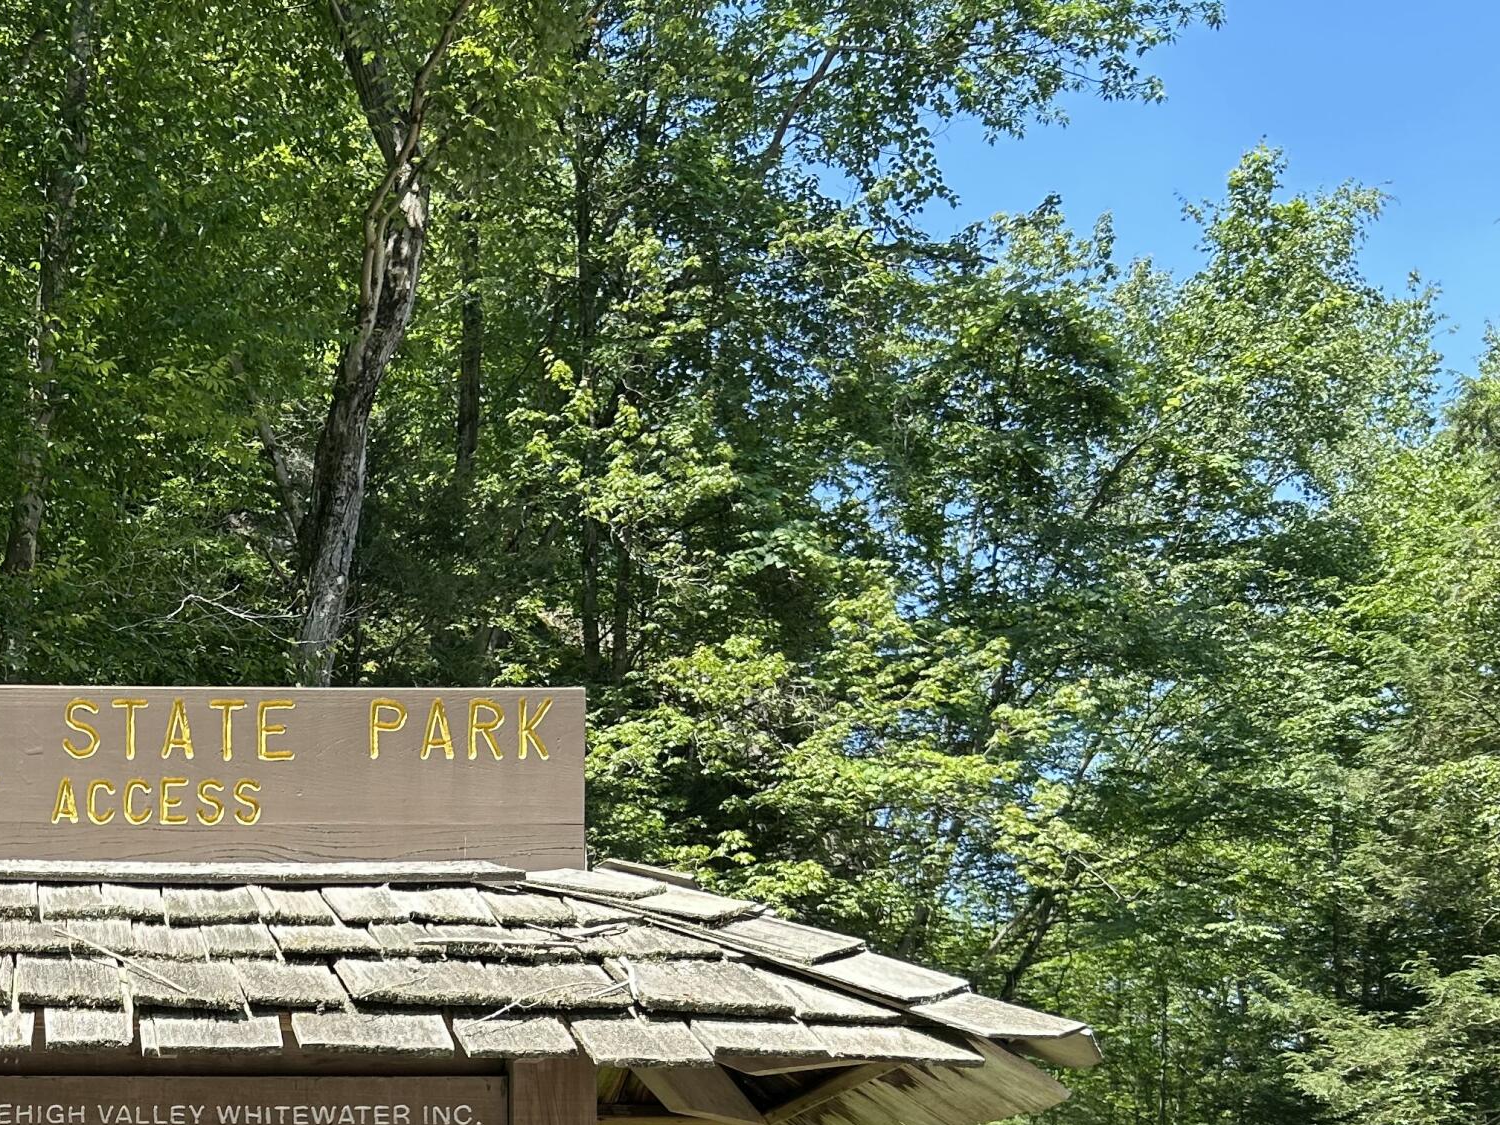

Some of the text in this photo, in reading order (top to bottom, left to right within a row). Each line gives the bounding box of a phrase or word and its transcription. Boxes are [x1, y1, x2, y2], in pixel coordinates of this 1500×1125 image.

[63, 698, 294, 760] STATE
[369, 697, 552, 758] PARK
[52, 776, 260, 825] ACCESS
[98, 1105, 204, 1124] VALLEY
[216, 1105, 410, 1125] WHITEWATER
[424, 1105, 481, 1125] INC.
